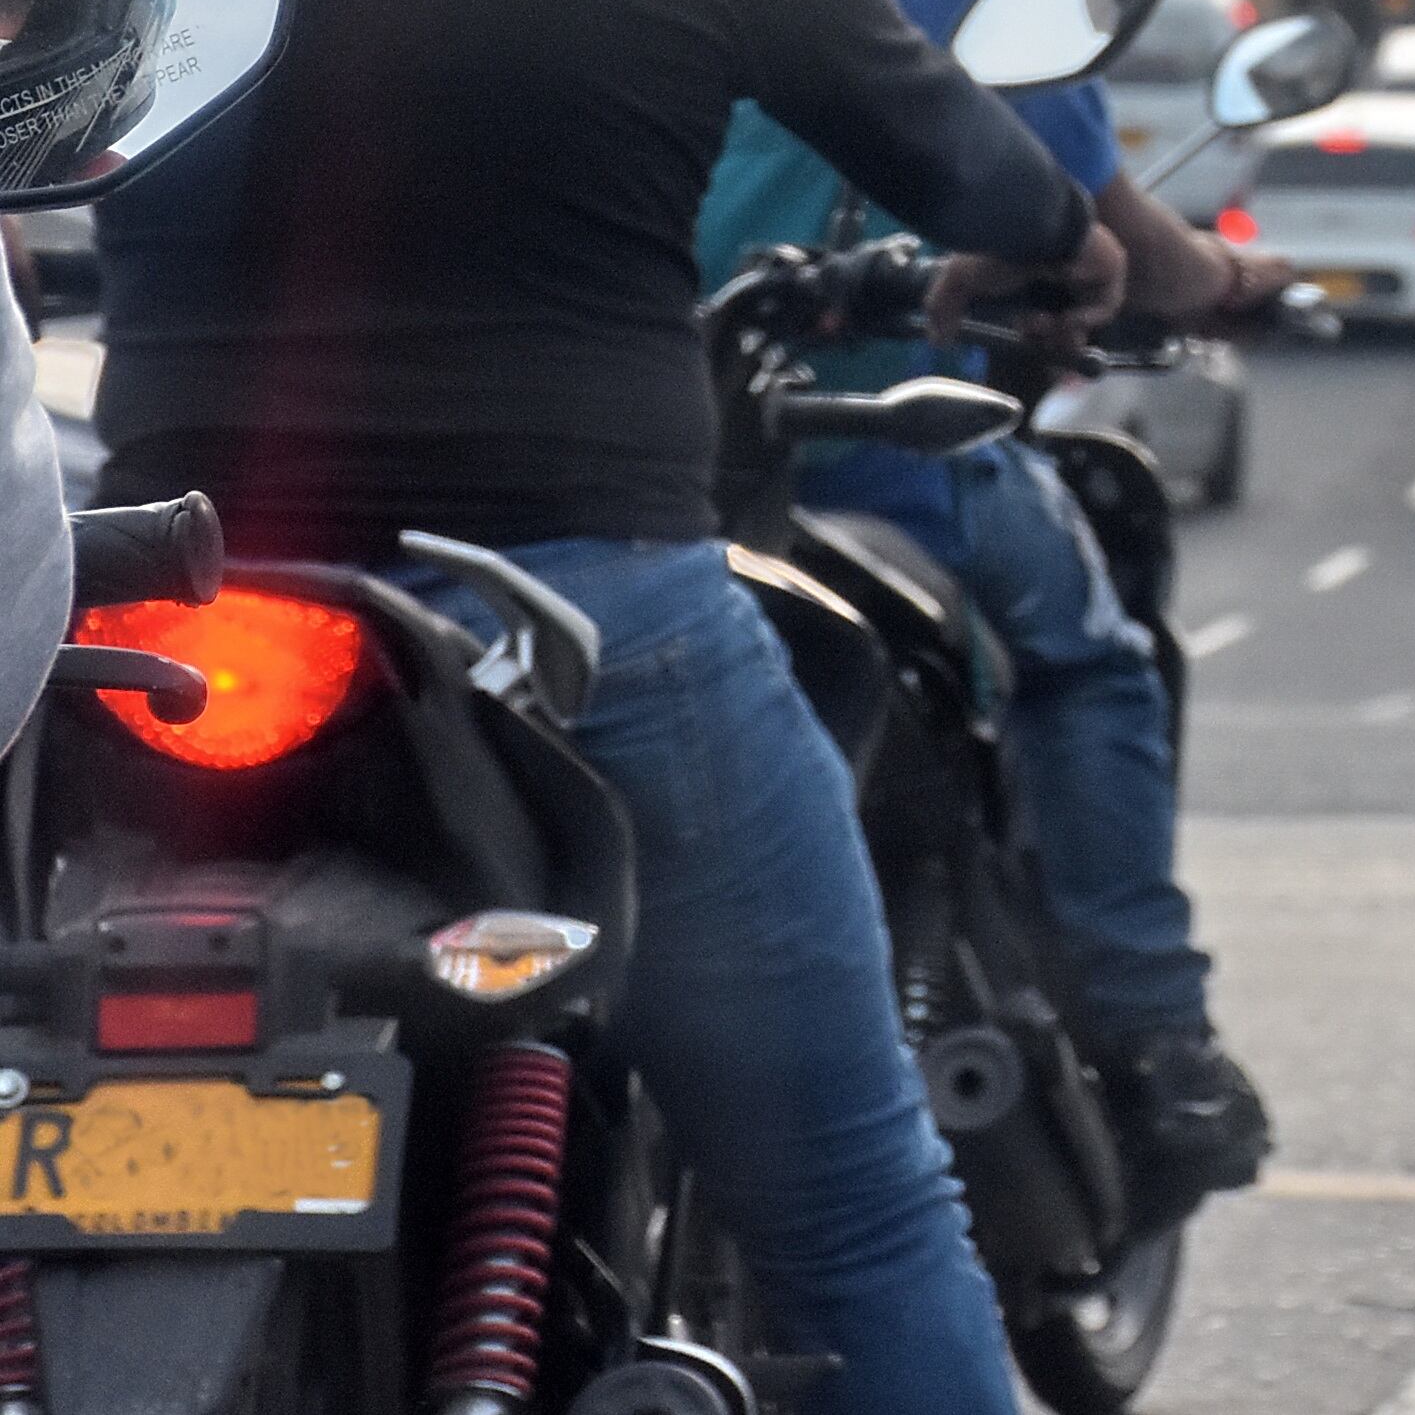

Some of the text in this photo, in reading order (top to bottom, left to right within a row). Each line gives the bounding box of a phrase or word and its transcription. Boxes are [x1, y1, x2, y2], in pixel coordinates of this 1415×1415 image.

[35, 82, 55, 103] IN
[54, 67, 91, 94] THE
[161, 28, 196, 55] ARE
[41, 97, 89, 130] THAN
